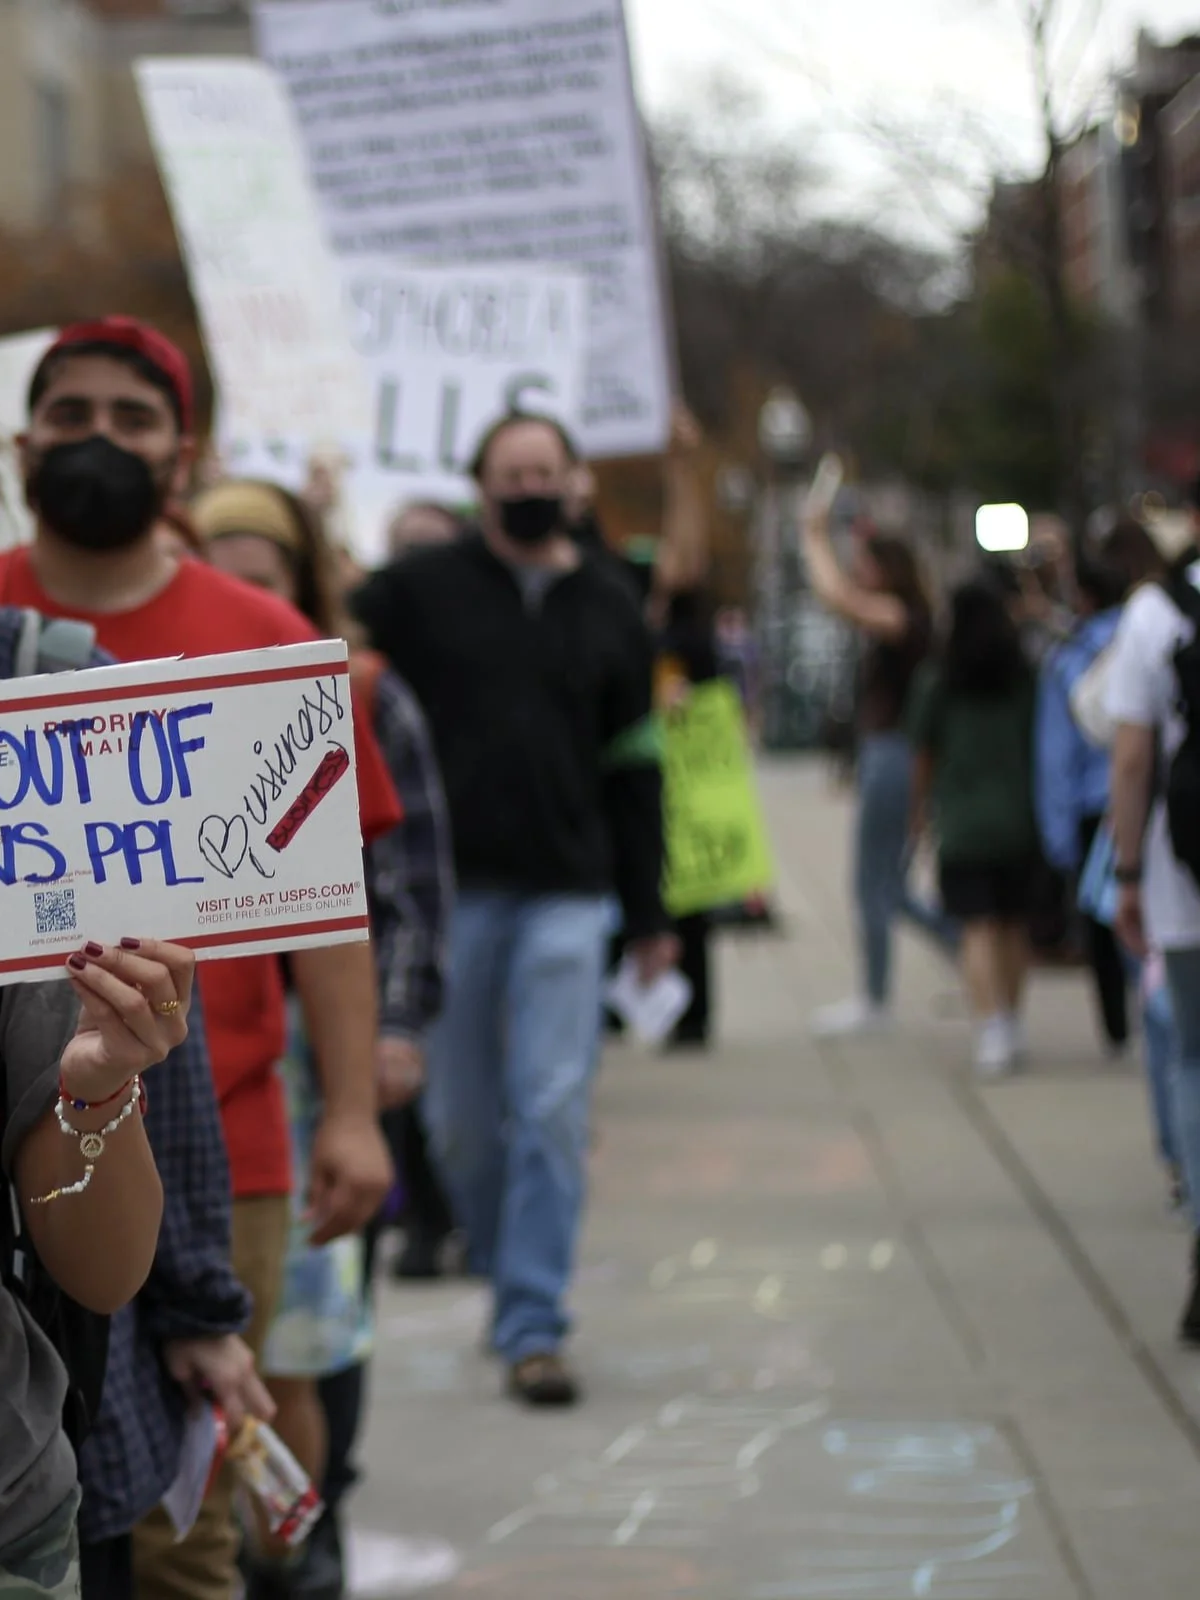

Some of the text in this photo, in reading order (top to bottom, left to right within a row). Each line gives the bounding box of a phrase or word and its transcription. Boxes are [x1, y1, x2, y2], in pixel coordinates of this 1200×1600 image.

[84, 819, 204, 886] PPL
[198, 676, 344, 878] Business
[128, 702, 213, 806] OF
[196, 898, 231, 913] VISIT
[235, 896, 254, 908] US
[258, 893, 275, 905] AT
[198, 897, 353, 925] ORDER FREE SUPPLIES ONLINE
